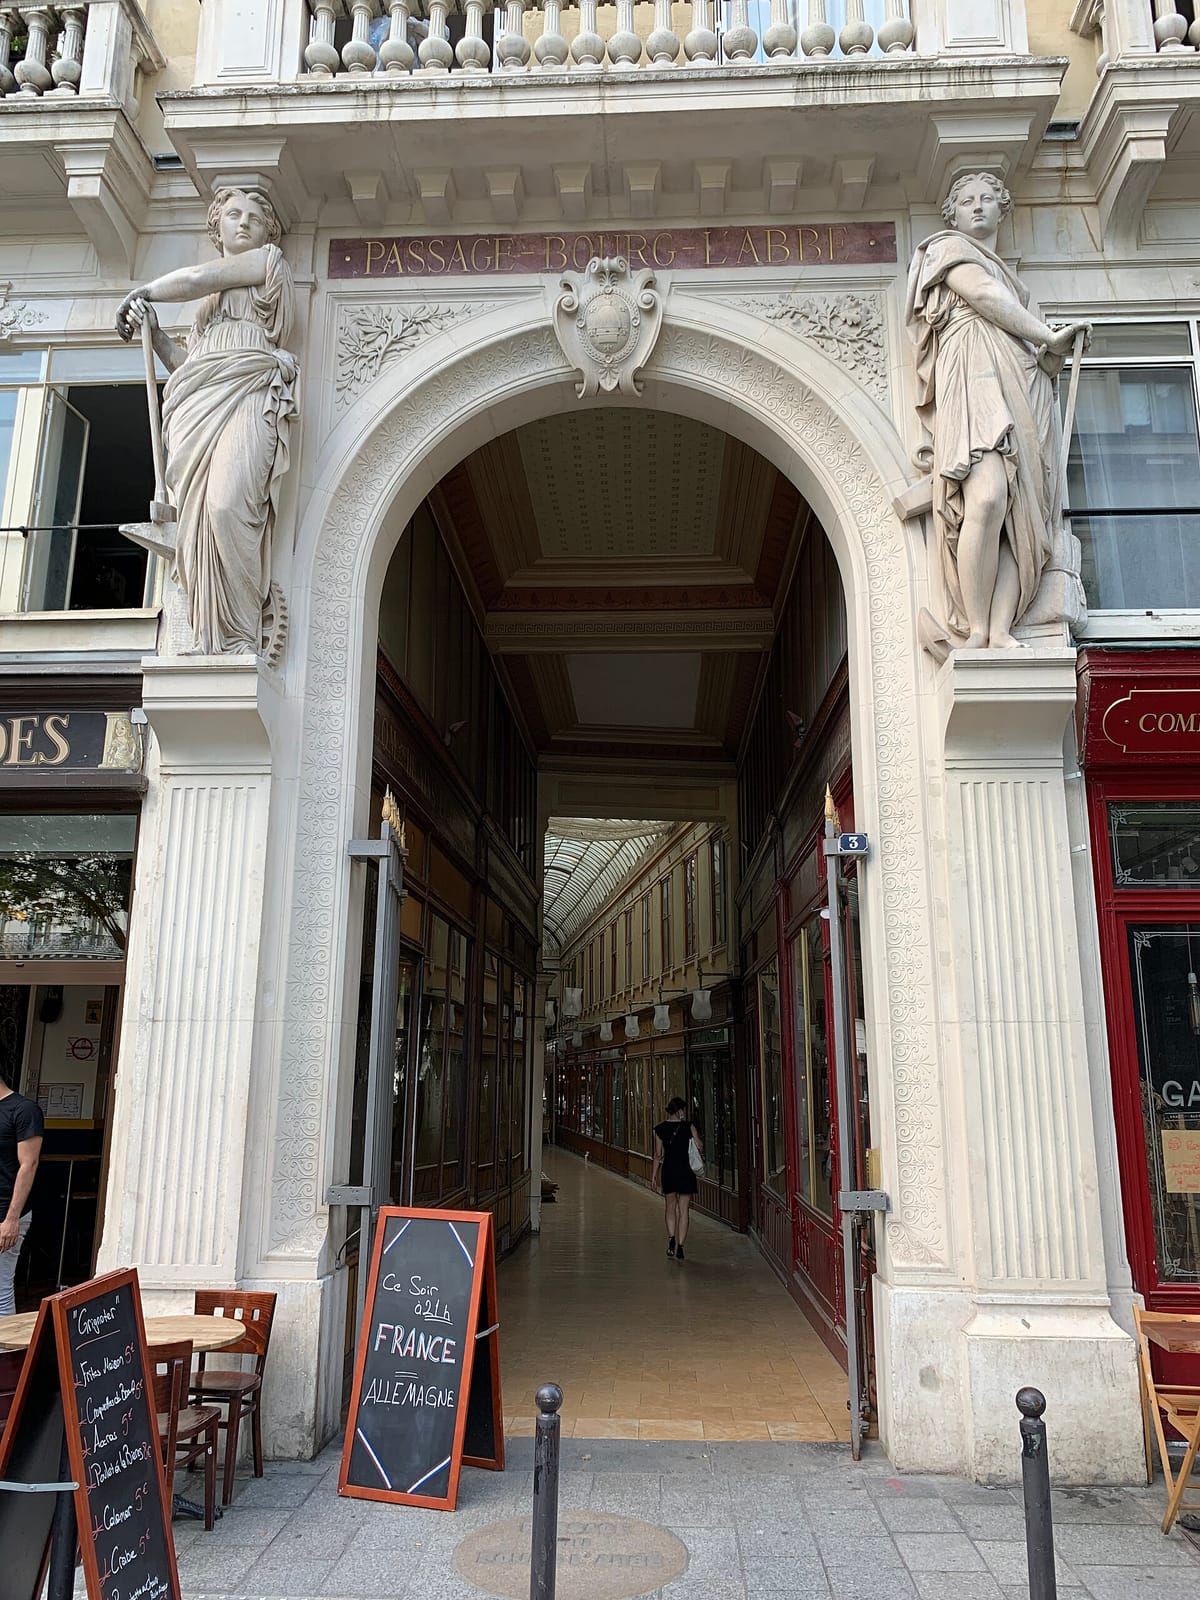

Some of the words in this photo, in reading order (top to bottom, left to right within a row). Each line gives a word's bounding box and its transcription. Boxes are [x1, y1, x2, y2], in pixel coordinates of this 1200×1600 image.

[363, 237, 515, 275] PASSAGE
[543, 232, 677, 271] BOURG
[1138, 712, 1200, 733] COM
[848, 836, 859, 849] 3
[382, 1273, 402, 1292] Ce
[409, 1275, 439, 1297] Soir
[374, 1323, 457, 1365] FRANCE
[362, 1377, 455, 1409] ALLEMAGNE
[103, 1504, 133, 1530] Calamar
[111, 1545, 137, 1574] Crabe
